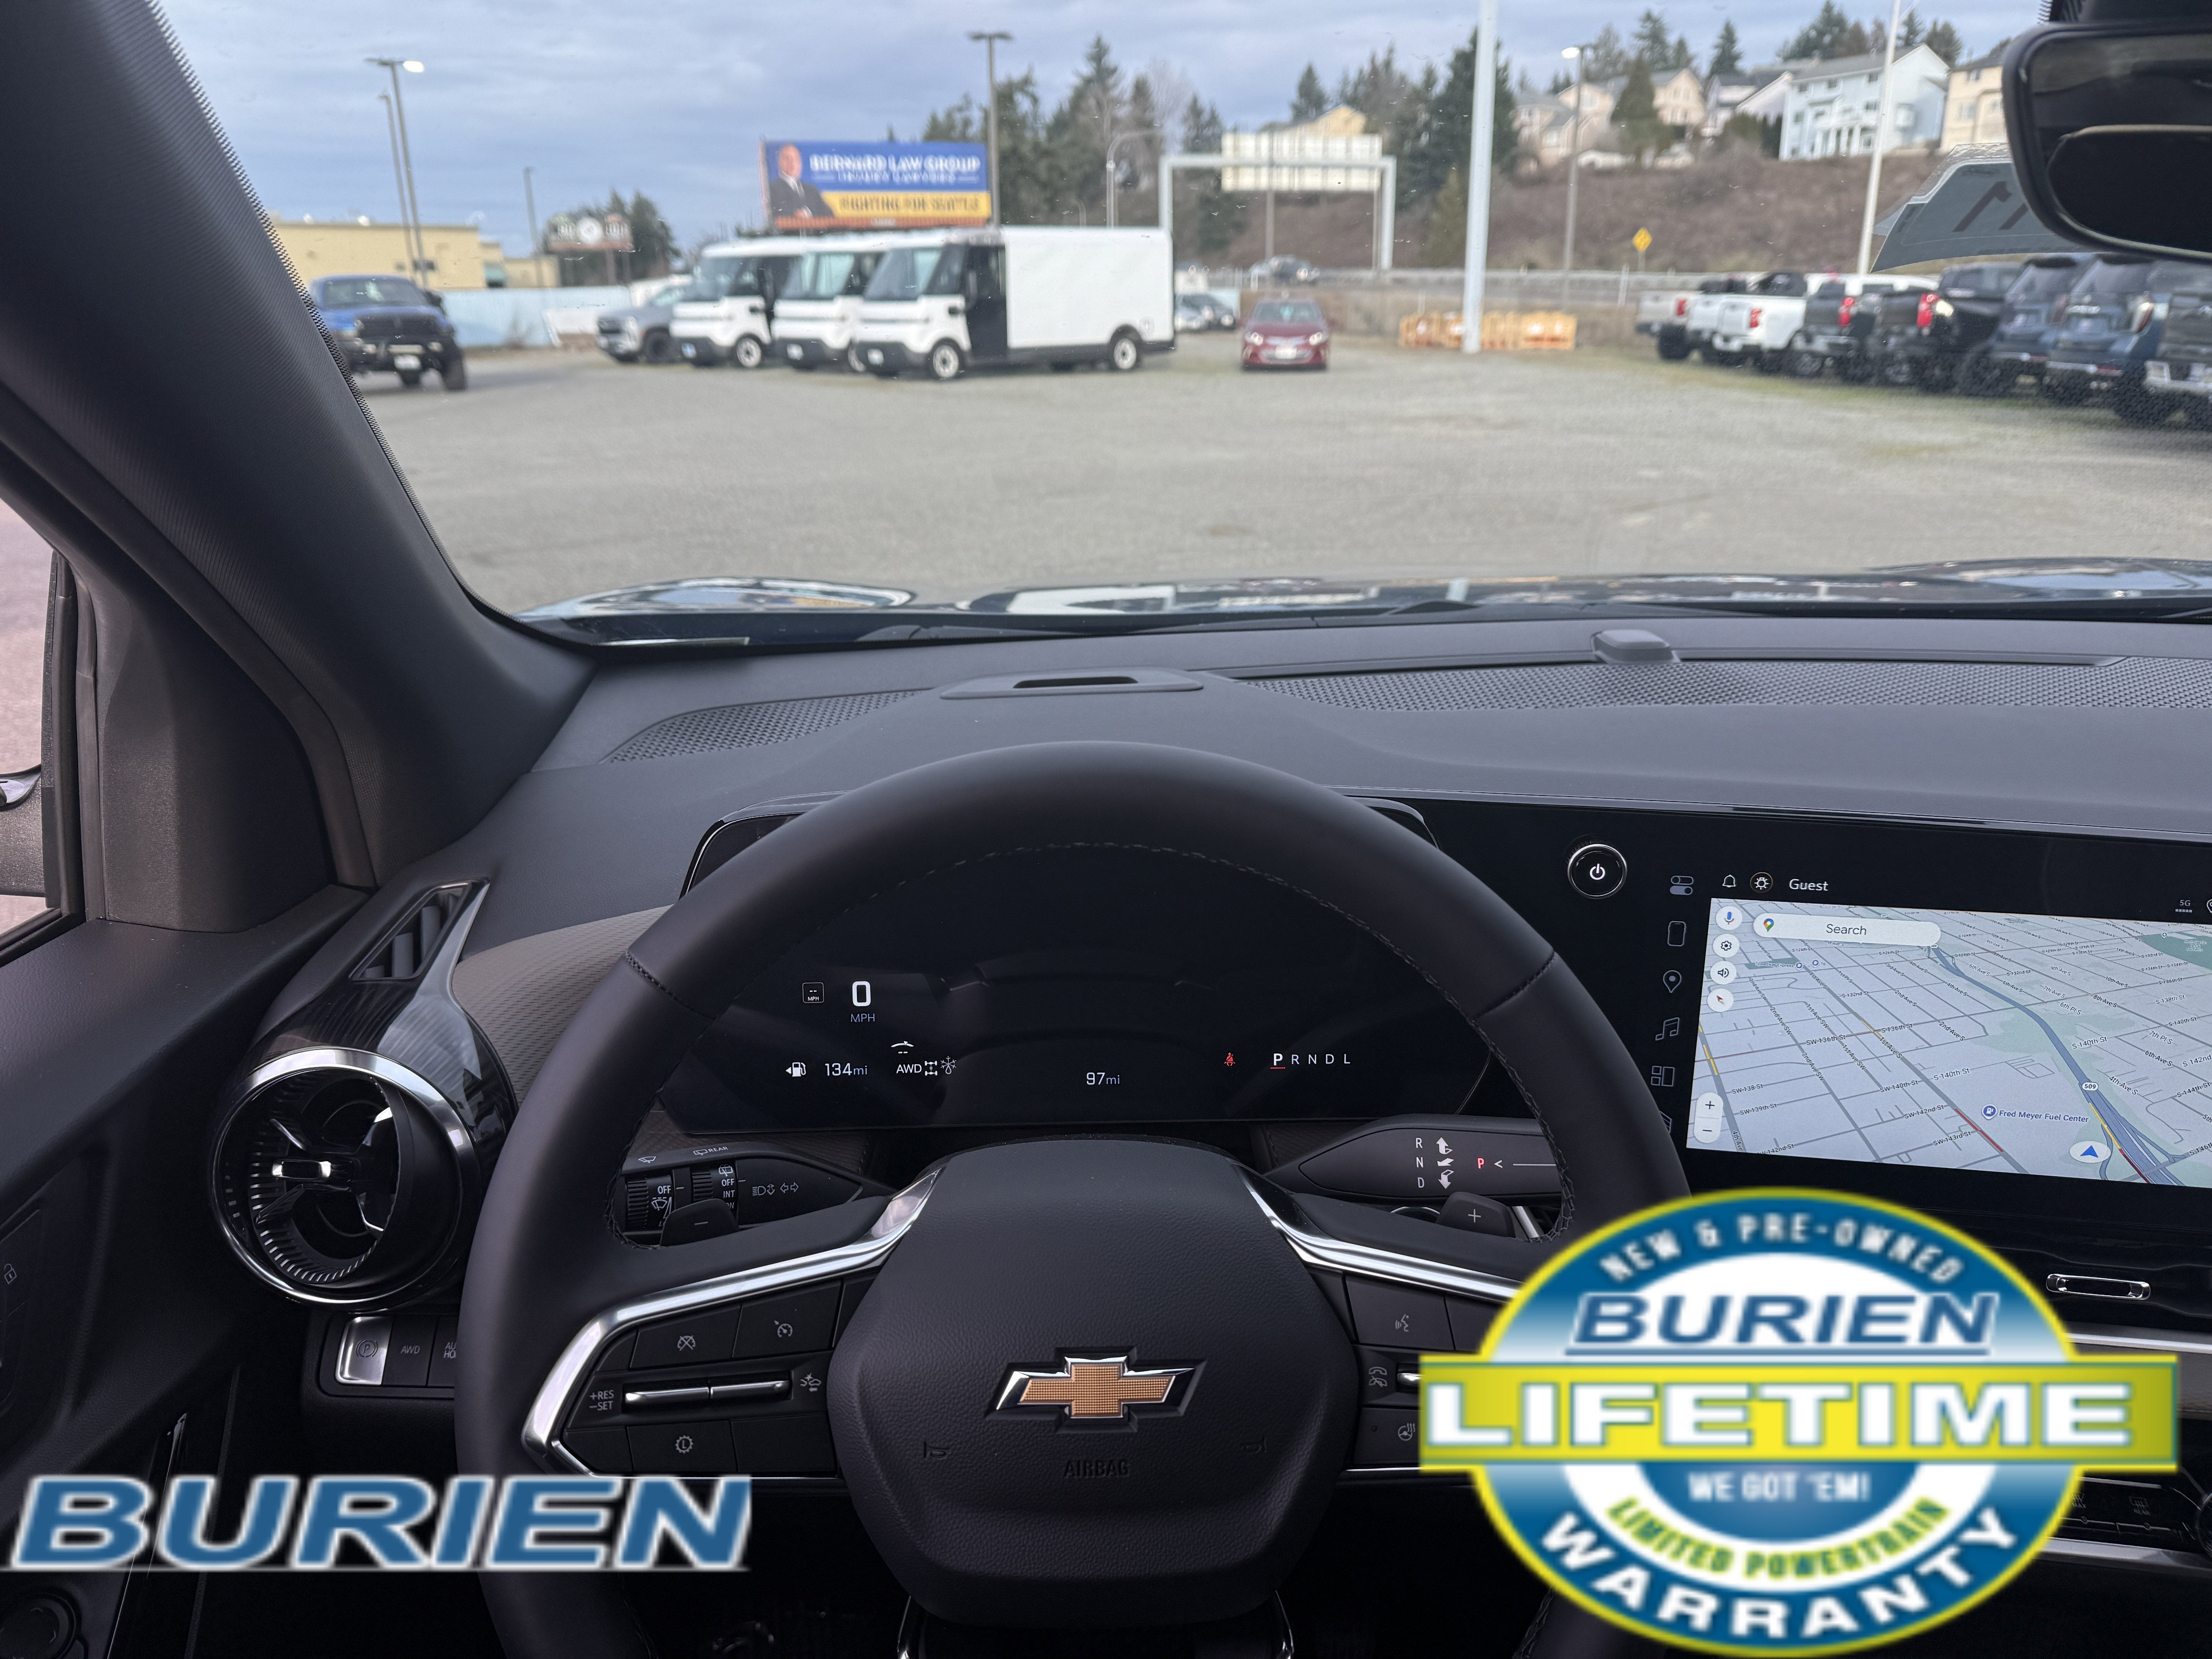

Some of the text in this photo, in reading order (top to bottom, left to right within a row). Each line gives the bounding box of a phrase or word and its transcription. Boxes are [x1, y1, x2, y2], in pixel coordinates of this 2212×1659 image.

[809, 155, 981, 172] BERNARD LAW GROUP
[1789, 878, 1828, 891] Guest
[1826, 924, 1867, 936] Search
[852, 981, 871, 1006] 0
[1895, 989, 1903, 998] 2nd
[1903, 996, 1913, 1004] Ave
[850, 1013, 875, 1023] MPH
[1806, 1004, 1829, 1029] 1st Ave SW
[1939, 1021, 1950, 1031] 2nd
[1949, 1029, 1960, 1038] Ave
[2148, 1030, 2159, 1039] 7th
[1879, 1037, 1889, 1047] 1st
[1887, 1044, 1898, 1055] Ave
[2078, 1039, 2098, 1048] 140th
[1273, 1053, 1350, 1066] P R N D L
[2145, 1050, 2155, 1058] 6th
[2154, 1055, 2167, 1064] Ave
[2190, 1054, 2212, 1065] 142nd
[896, 1064, 922, 1073] AWD
[1941, 1070, 1961, 1079] 140th
[1892, 1081, 1910, 1090] 140th
[2109, 1075, 2120, 1085] 4th
[2119, 1082, 2132, 1092] Ave
[2183, 1085, 2202, 1095] 144th
[1752, 1105, 1769, 1113] 139th
[1916, 1106, 1936, 1116] 142nd
[2018, 1111, 2042, 1120] Meyer
[2202, 1114, 2212, 1123] 5th
[1416, 1137, 1422, 1148] R
[1944, 1133, 1963, 1142] 143rd
[1416, 1157, 1424, 1168] N
[1477, 1158, 1485, 1169] P
[721, 1178, 735, 1187] OFF
[1417, 1177, 1425, 1188] D
[658, 1185, 672, 1195] OFF
[723, 1190, 735, 1198] INT
[400, 1345, 420, 1354] AWD
[1063, 1460, 1130, 1478] AIRBAG
